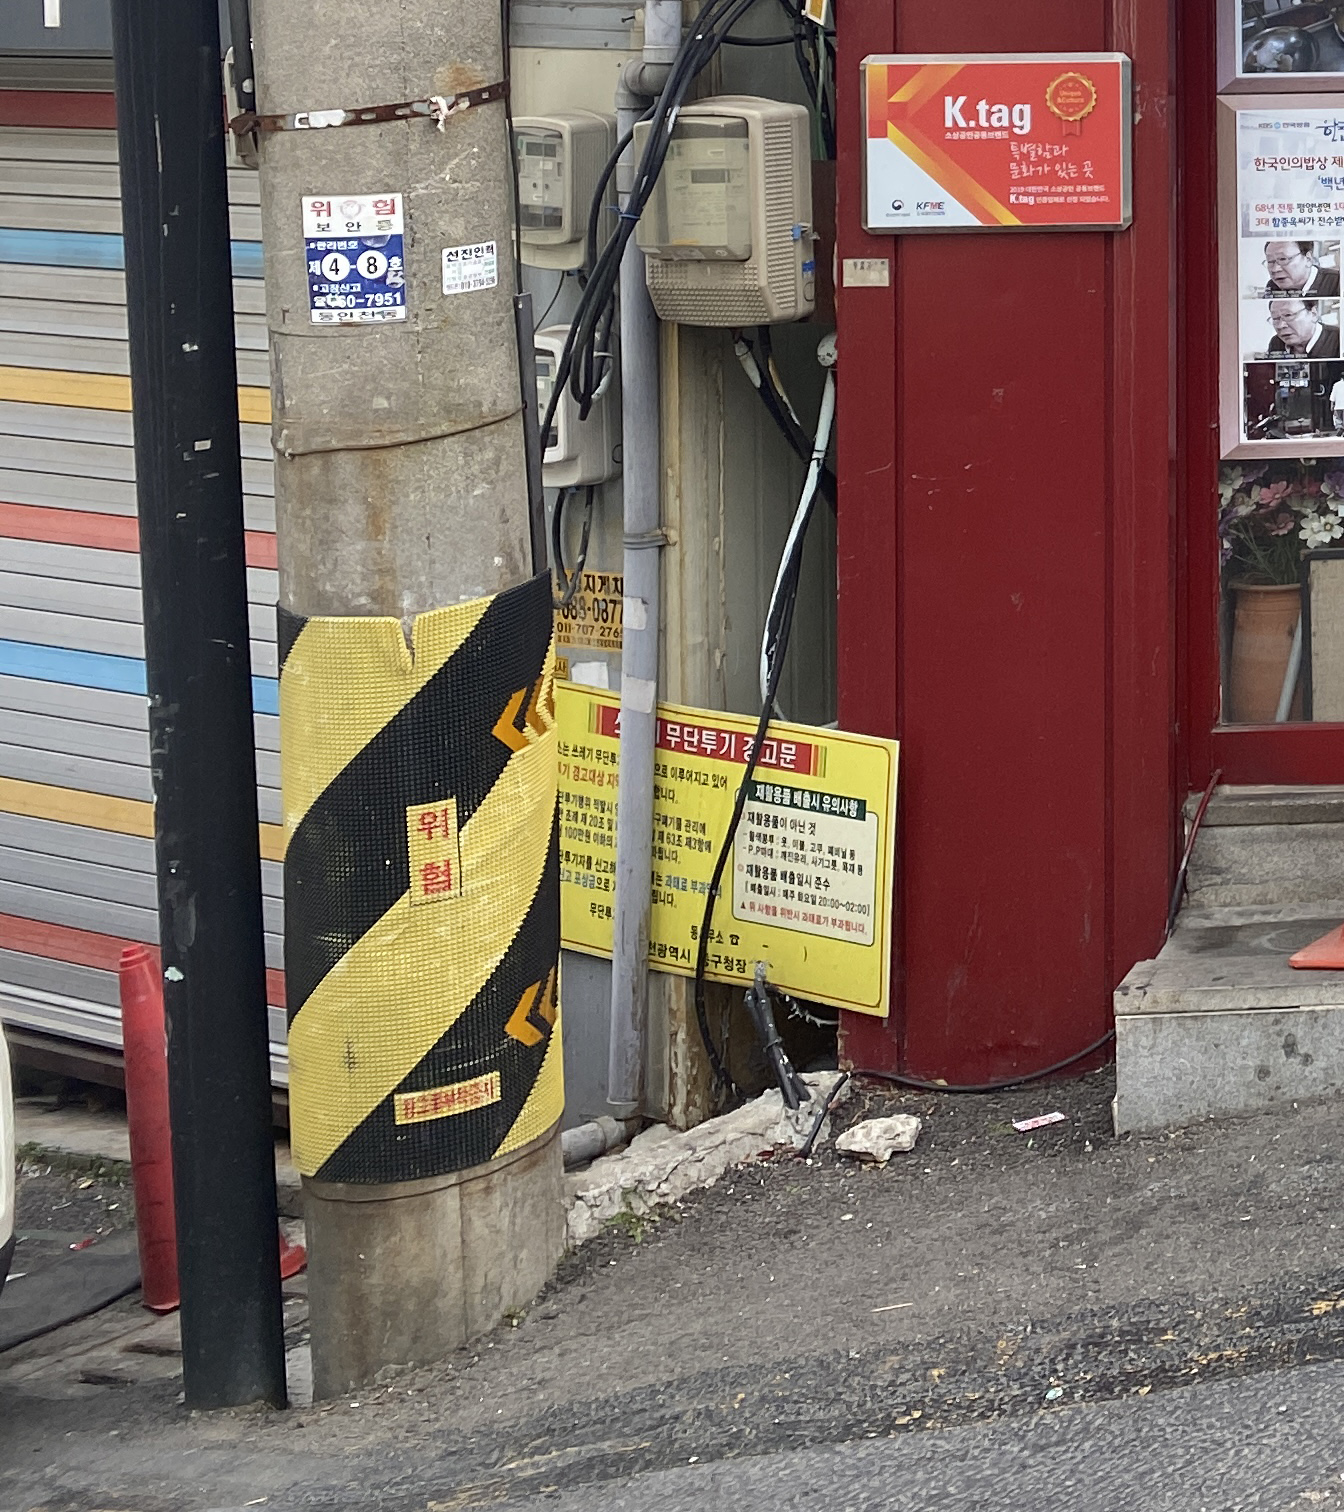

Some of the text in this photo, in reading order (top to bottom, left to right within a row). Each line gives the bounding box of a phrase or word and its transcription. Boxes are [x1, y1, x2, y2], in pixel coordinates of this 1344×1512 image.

[944, 96, 1033, 136] K.tag
[1009, 140, 1070, 162] 특별함과
[1009, 160, 1095, 180] 문화가 있는 곳
[1253, 156, 1328, 172] 한국인의밥상
[309, 199, 396, 218] 위험
[1009, 193, 1035, 206] K.tag
[1277, 203, 1295, 214] 전통
[1255, 217, 1270, 227] 3대
[446, 244, 495, 263] 선진인력
[326, 292, 402, 309] 60-7951
[666, 724, 736, 760] 무단투기
[571, 743, 729, 793] 쓰레기 무단투 이루어지고 있어
[572, 765, 606, 788] 경고대상
[755, 782, 859, 818] 재활용품 배출시 유의사항
[747, 811, 817, 837] 재활용품이 아닌 것
[416, 806, 453, 897] 위험
[746, 863, 831, 893] 재활용품 배출일시 준수
[589, 901, 616, 922] 무단투
